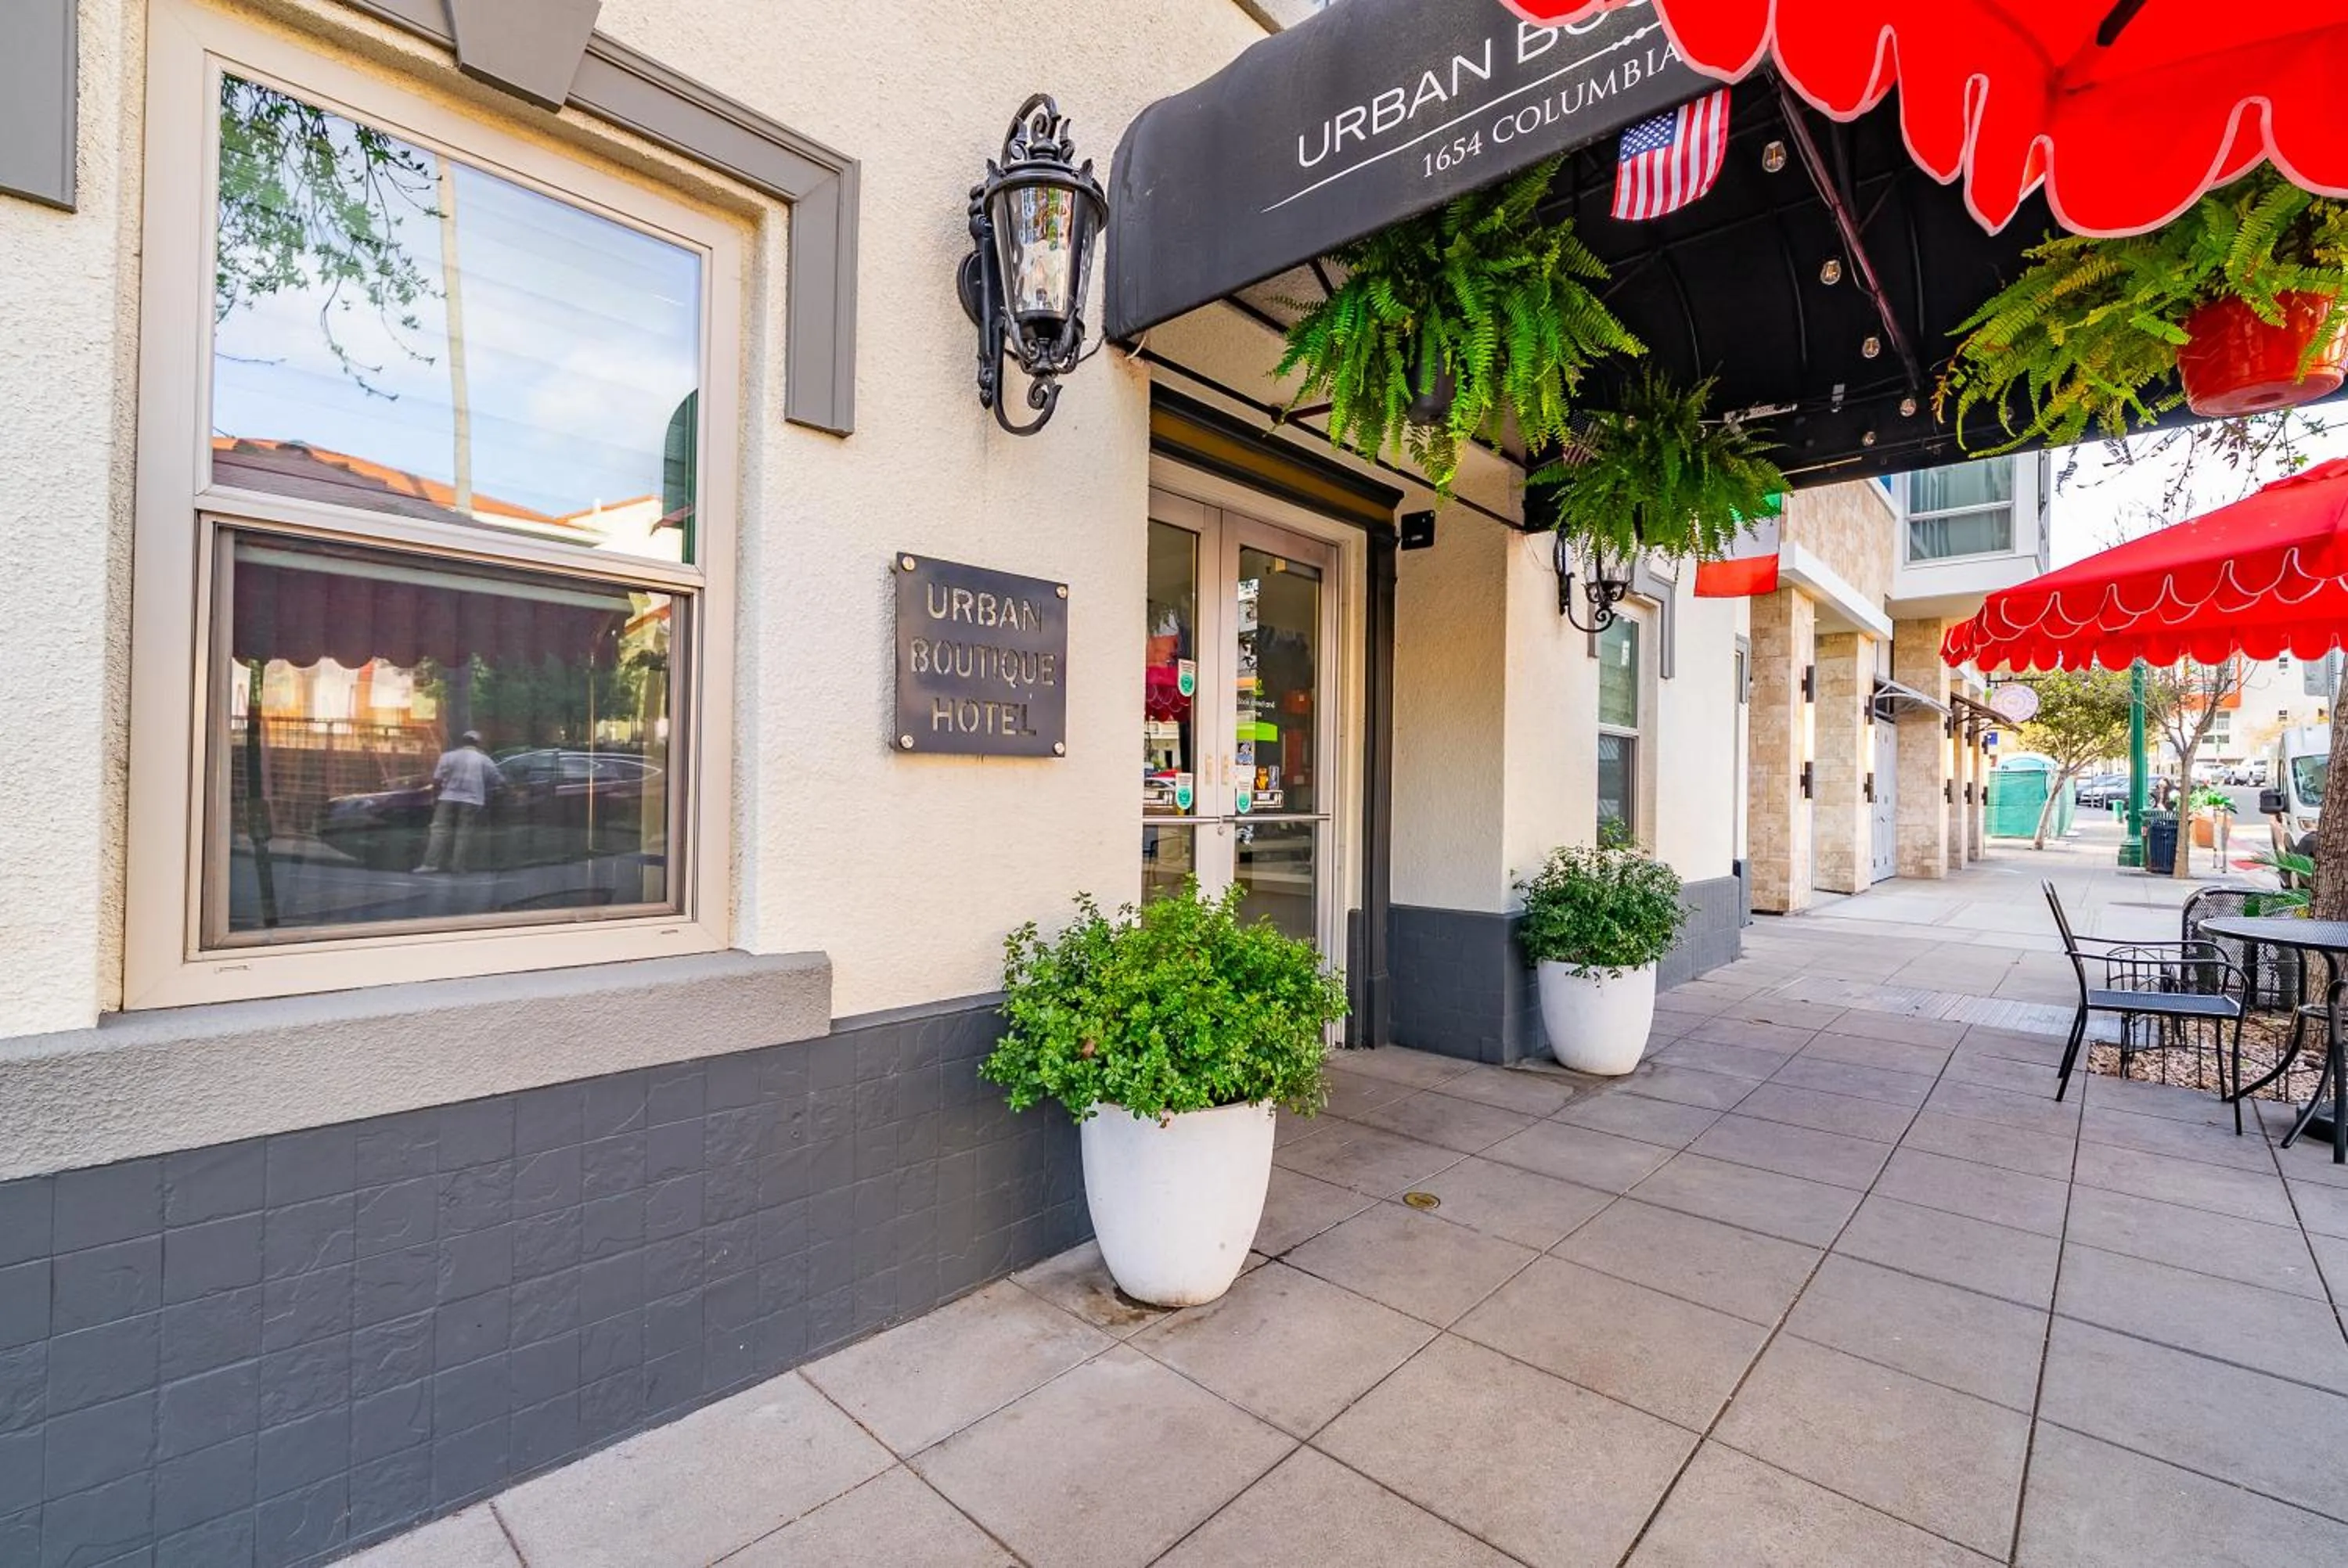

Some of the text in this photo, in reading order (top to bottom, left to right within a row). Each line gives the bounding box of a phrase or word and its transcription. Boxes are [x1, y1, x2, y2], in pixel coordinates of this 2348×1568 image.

[1298, 37, 1492, 169] URBAN
[1422, 40, 1684, 178] 1654 COLUMBIA
[927, 582, 1043, 634] URBAN
[909, 636, 1057, 689] BOUTIQUE
[931, 696, 1038, 736] HOTEL
